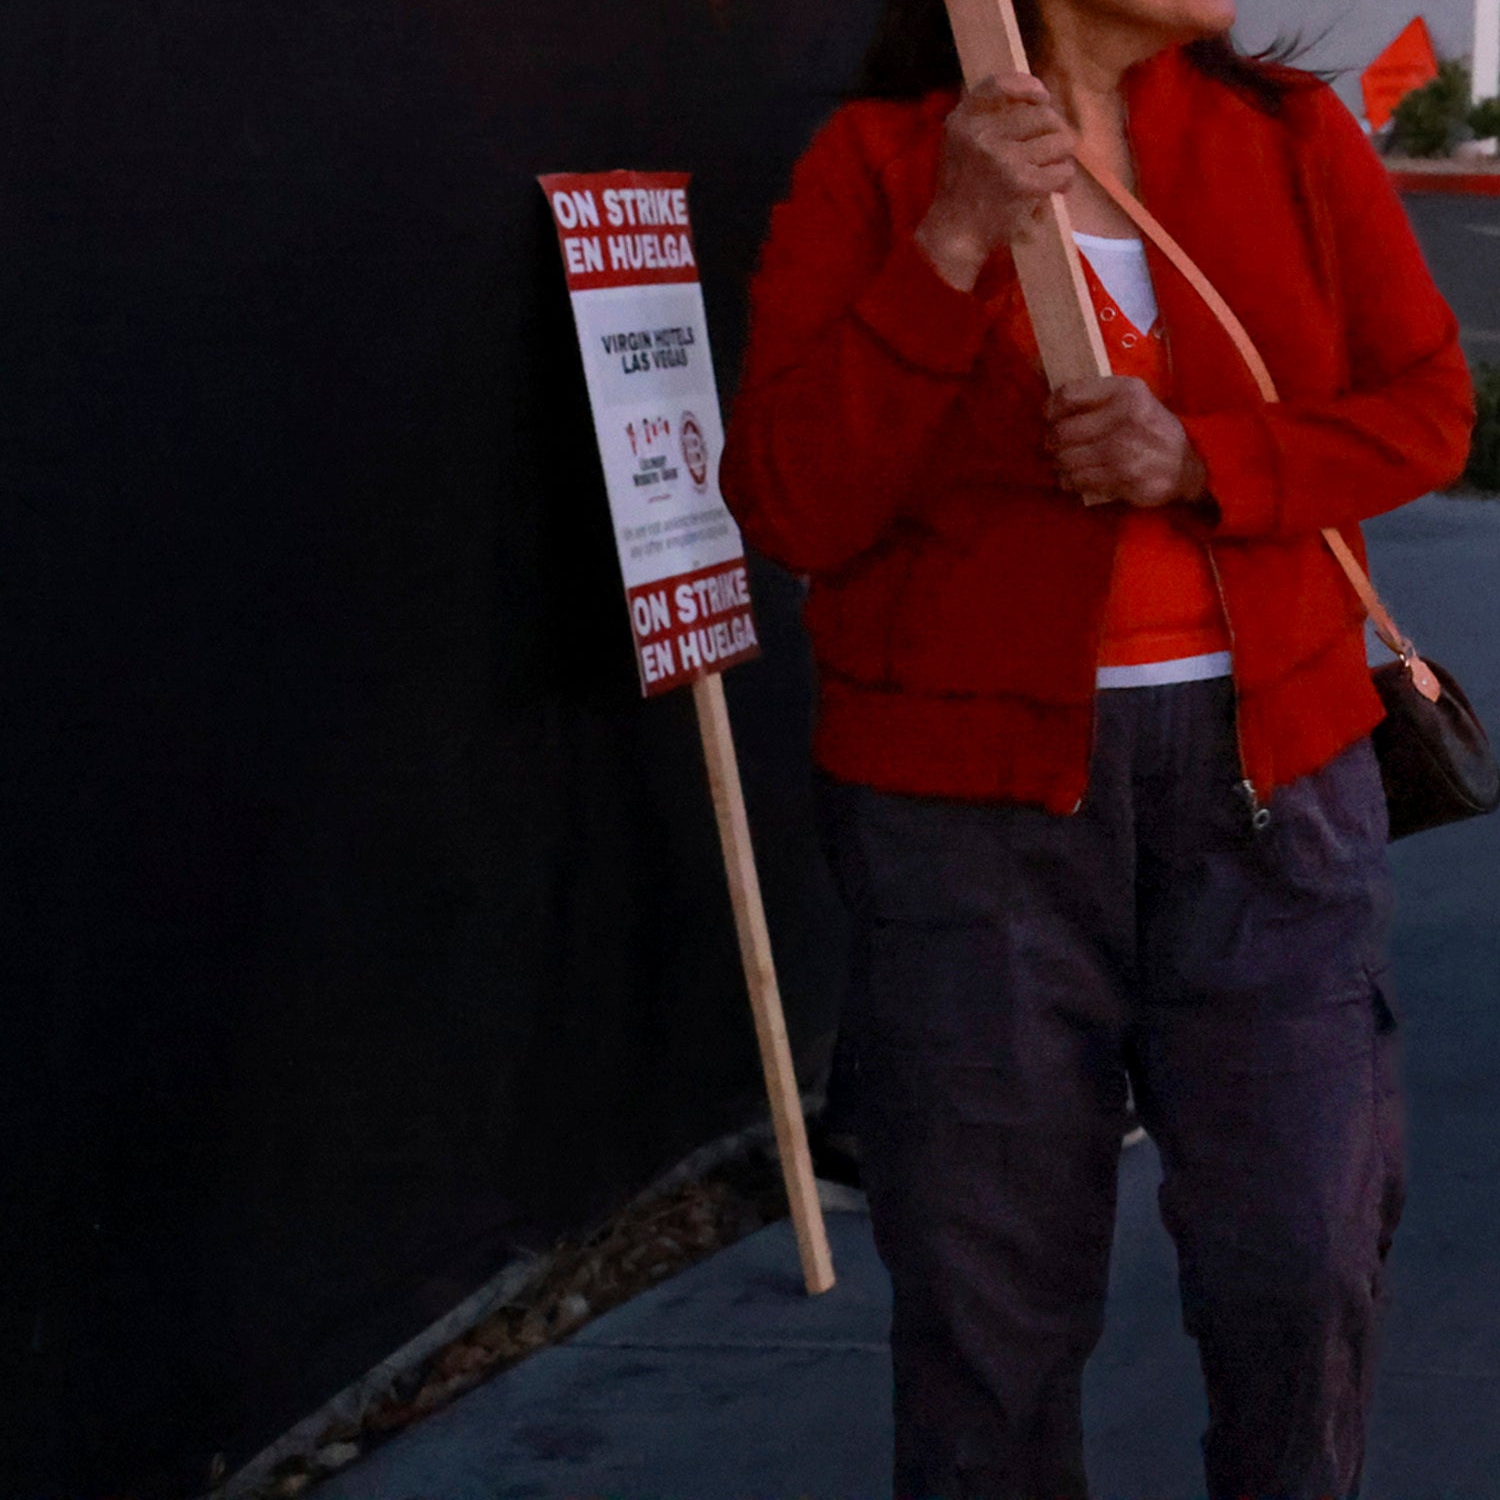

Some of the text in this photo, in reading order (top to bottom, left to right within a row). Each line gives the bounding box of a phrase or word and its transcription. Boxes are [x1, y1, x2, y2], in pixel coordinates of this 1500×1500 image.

[552, 188, 689, 229] ON STRIKE
[564, 234, 696, 273] EN HUELGA
[601, 331, 653, 354] VIRGIN
[621, 352, 650, 374] LAS
[633, 567, 751, 637] ON STRIKE
[642, 613, 758, 683] EN HUELGA
